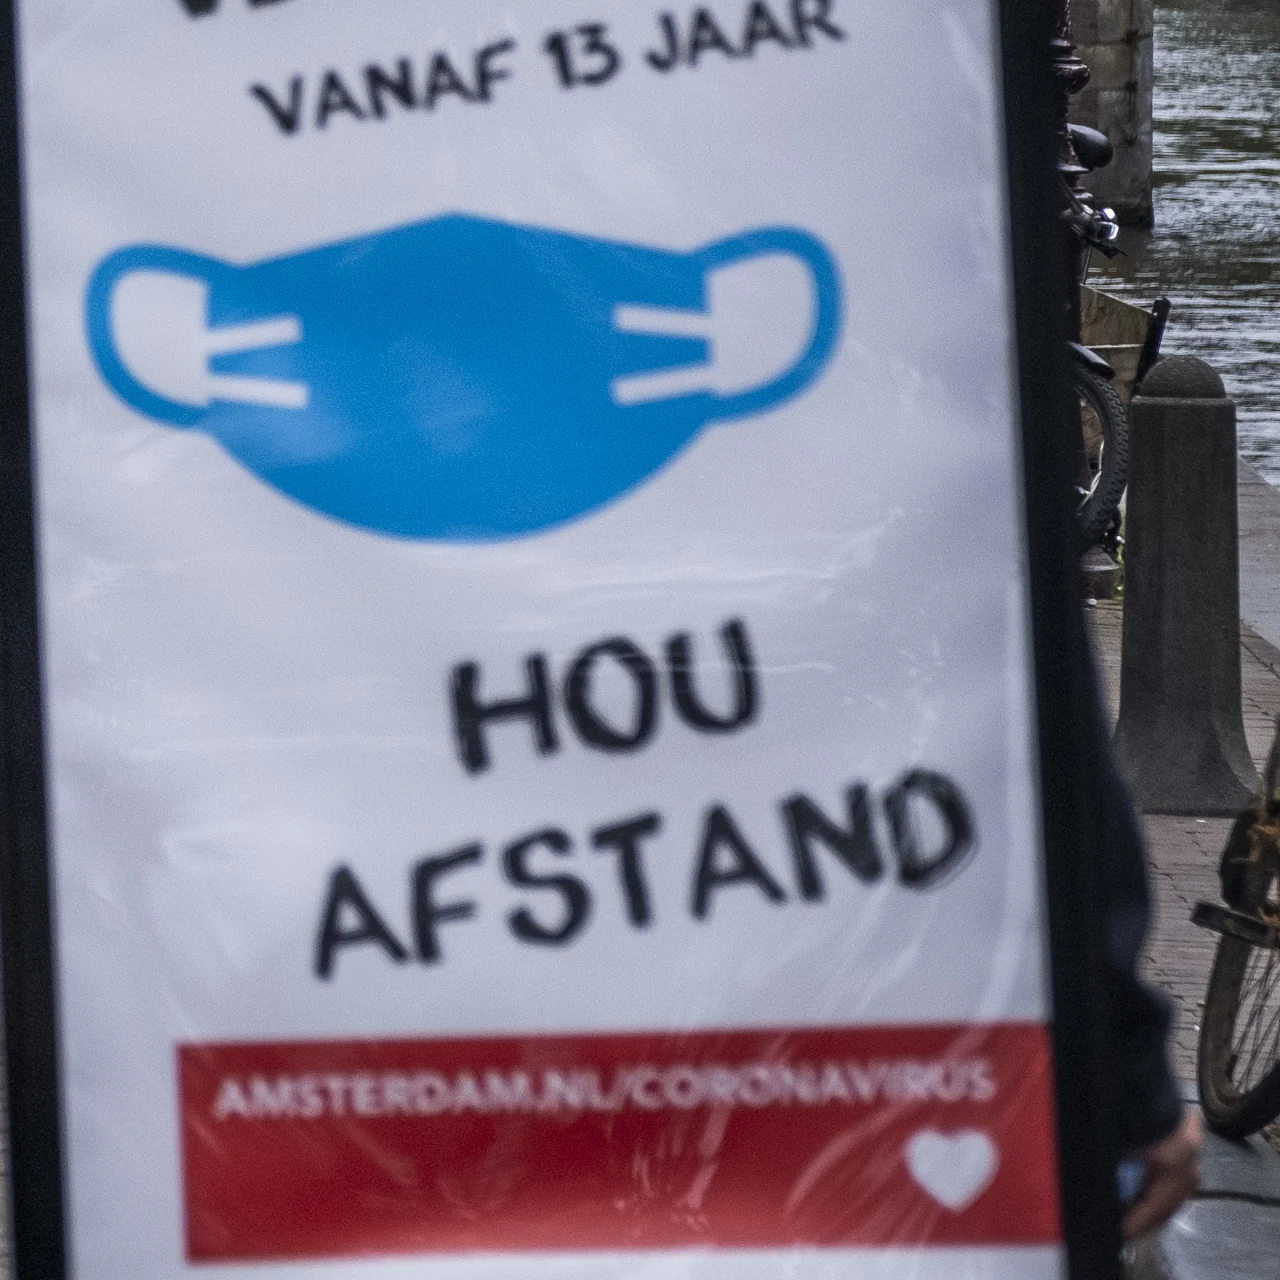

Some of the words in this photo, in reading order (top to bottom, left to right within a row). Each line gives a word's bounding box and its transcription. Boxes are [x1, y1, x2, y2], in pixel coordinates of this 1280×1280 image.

[248, 37, 516, 137] VANAF
[541, 21, 622, 90] 13
[447, 618, 763, 776] HOU
[312, 766, 982, 982] AFSTAND
[214, 1058, 997, 1118] AMSTERDAM.NL/CORONAVIRUS
